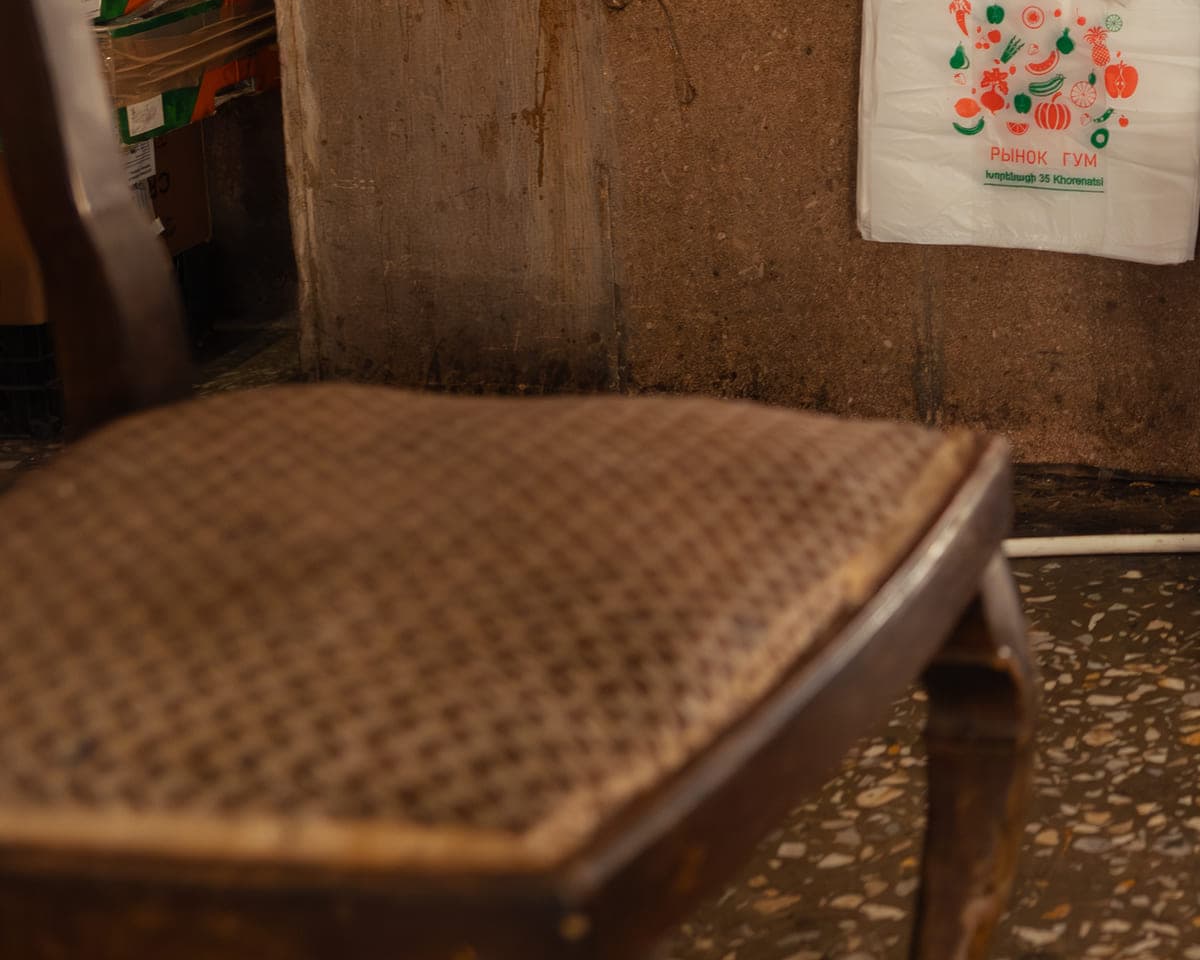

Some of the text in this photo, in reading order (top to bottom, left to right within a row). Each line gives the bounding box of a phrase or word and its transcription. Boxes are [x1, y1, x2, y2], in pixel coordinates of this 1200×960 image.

[990, 146, 1098, 168] РЫНОК ГУМ
[1038, 173, 1051, 183] 35
[1053, 174, 1104, 187] Khorenatsi
